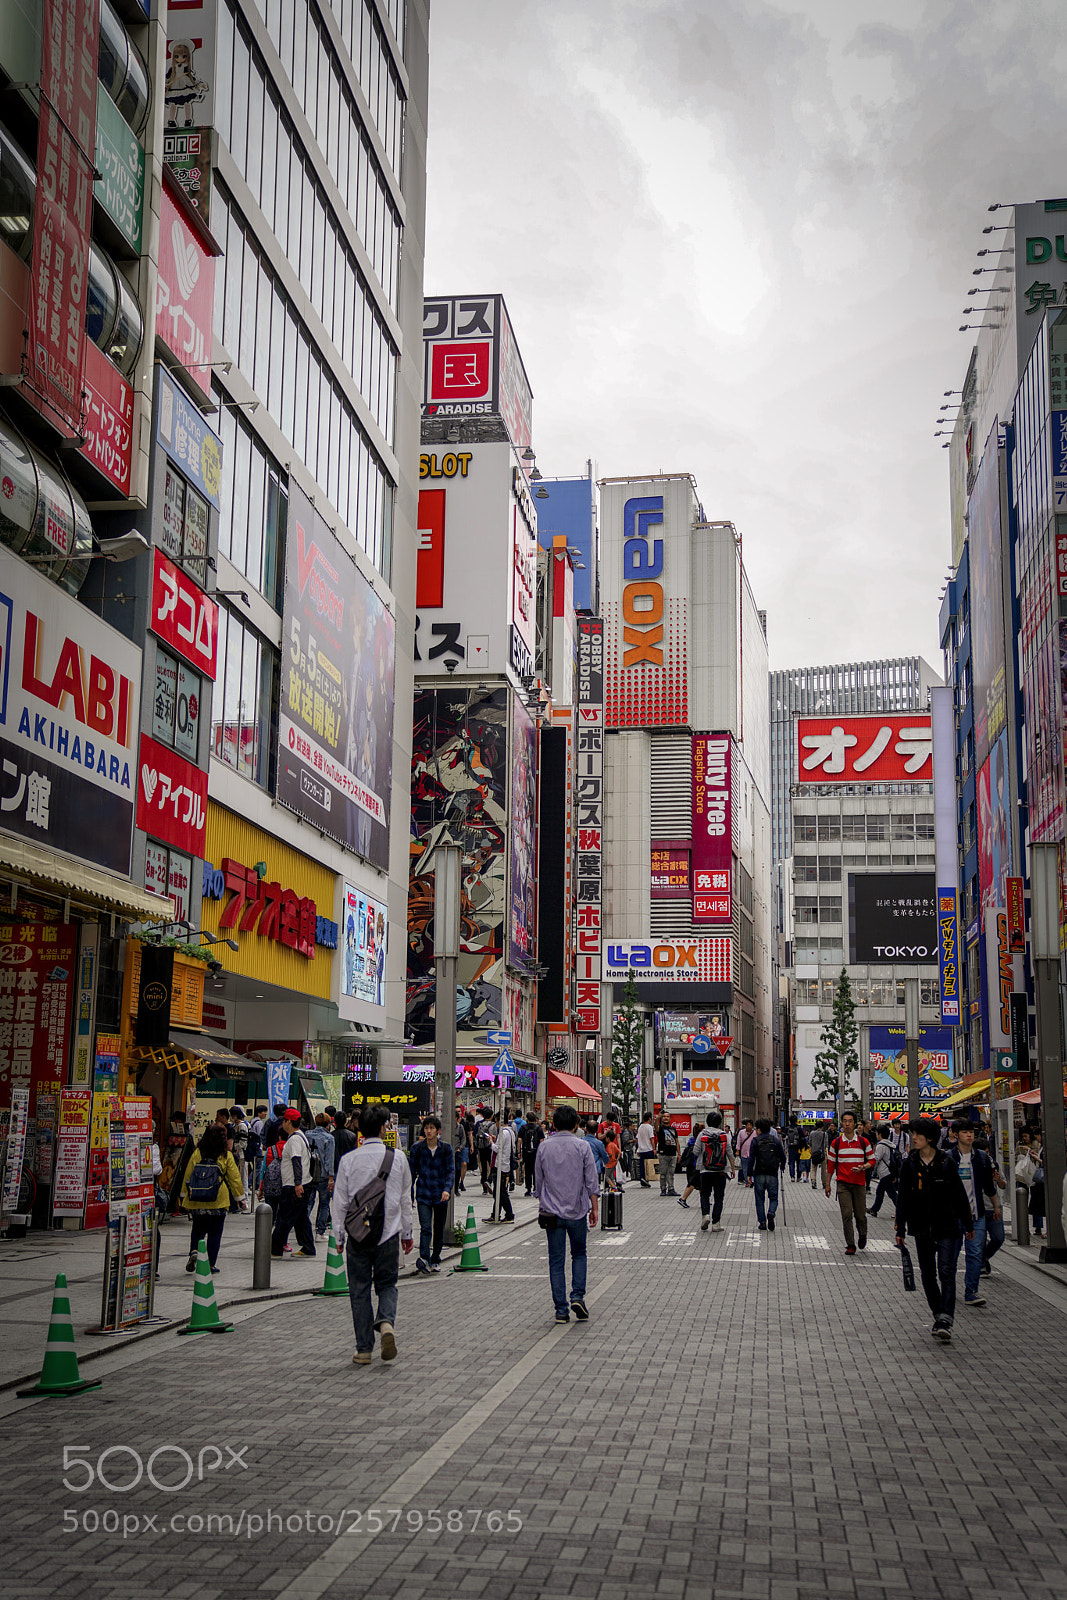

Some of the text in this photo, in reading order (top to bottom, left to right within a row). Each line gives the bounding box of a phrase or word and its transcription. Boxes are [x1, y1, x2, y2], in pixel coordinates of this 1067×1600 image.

[429, 403, 493, 415] PARADISE
[419, 452, 473, 479] SLOT
[158, 567, 213, 661] アコム
[22, 609, 132, 749] LABI
[579, 623, 591, 701] PARADISE
[18, 706, 131, 789] AKIHABARA
[696, 740, 706, 814] Flagship Store
[158, 771, 205, 830] アイフル
[705, 739, 729, 836] Duty Free
[696, 873, 728, 889] 免税
[696, 900, 728, 913] 면세점
[606, 969, 629, 978] Home
[676, 969, 698, 978] Store
[873, 946, 928, 957] TOKYO
